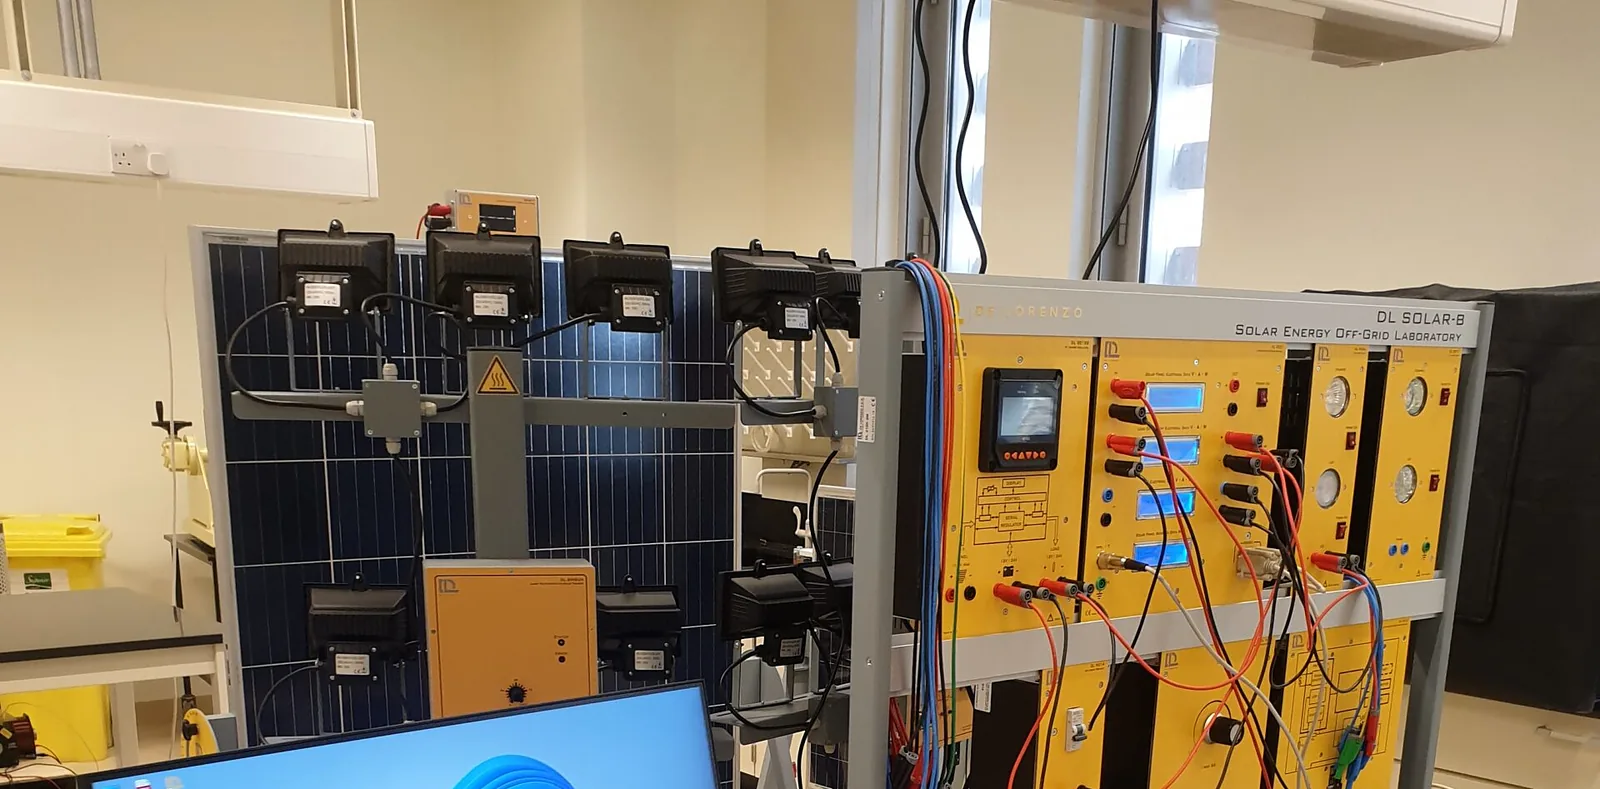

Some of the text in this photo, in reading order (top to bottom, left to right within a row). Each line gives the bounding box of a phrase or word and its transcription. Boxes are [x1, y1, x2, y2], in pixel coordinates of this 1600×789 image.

[1008, 305, 1083, 319] ORENZO
[1376, 310, 1465, 326] DL SOLAR-B
[1235, 324, 1462, 342] SOLAR ENERGY OFF-GRID LABORATORY
